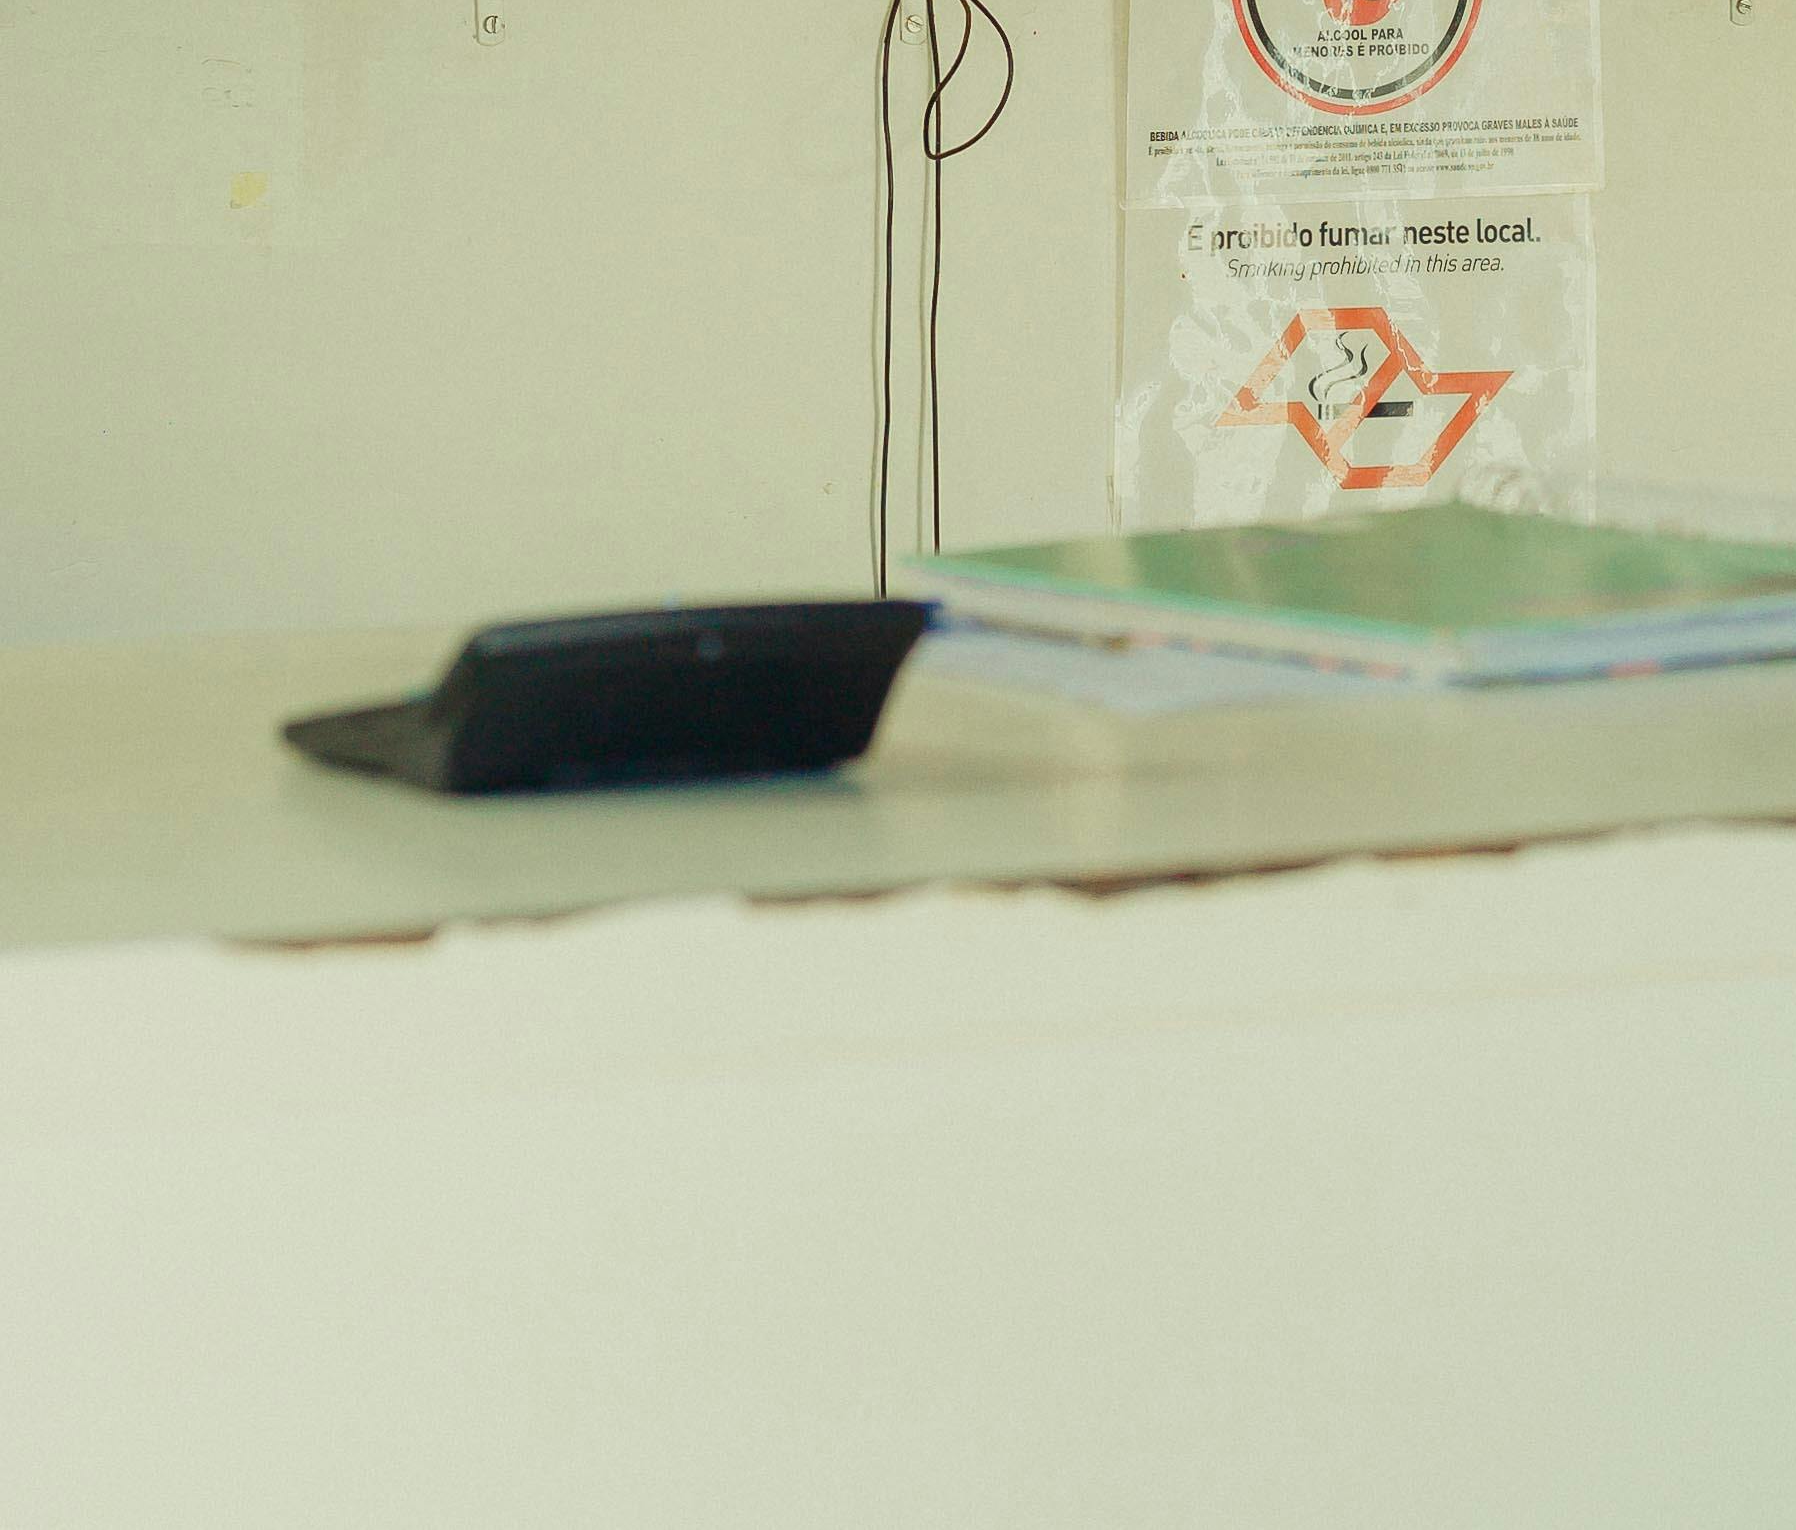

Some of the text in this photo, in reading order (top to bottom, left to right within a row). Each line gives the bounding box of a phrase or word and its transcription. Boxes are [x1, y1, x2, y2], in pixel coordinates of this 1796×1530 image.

[1371, 27, 1404, 40] PARA
[1357, 42, 1365, 56] É
[1368, 42, 1430, 57] PROIBIDO
[1149, 131, 1180, 142] BEBIDA
[1389, 123, 1402, 134] EM
[1441, 120, 1481, 132] PROVOCA
[1481, 119, 1514, 130] GRAVES
[1515, 118, 1543, 130] MALES
[1552, 115, 1579, 128] SAÚDE
[1210, 221, 1313, 257] proibido
[1319, 220, 1397, 247] fumar
[1403, 220, 1470, 245] neste
[1476, 217, 1541, 244] local.
[1226, 253, 1505, 282] Smoking prohibited in this area.
